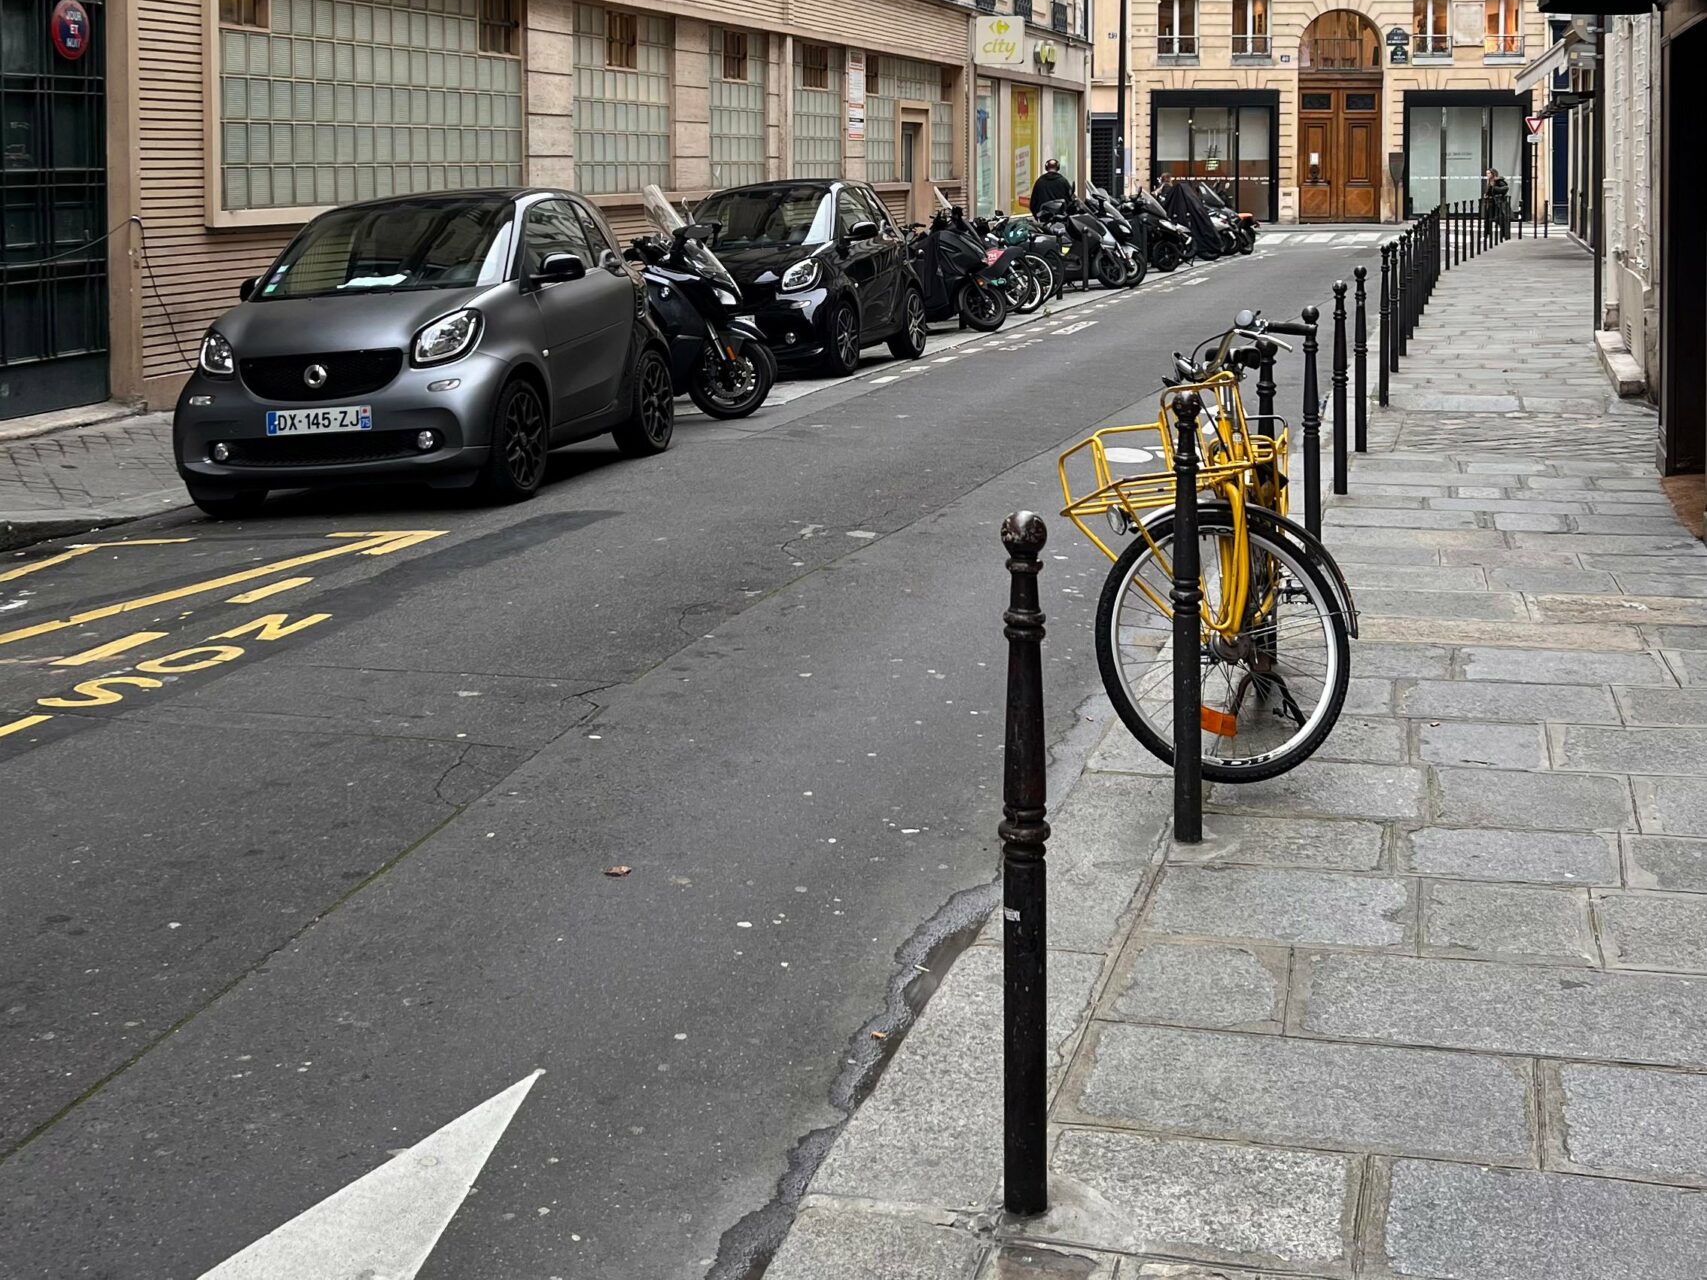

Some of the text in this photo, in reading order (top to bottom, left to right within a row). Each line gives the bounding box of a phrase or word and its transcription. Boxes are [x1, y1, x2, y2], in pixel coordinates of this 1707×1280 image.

[65, 10, 82, 21] JOUR
[70, 24, 79, 34] ET
[982, 39, 1016, 61] city
[277, 410, 360, 432] DX-145-ZJ
